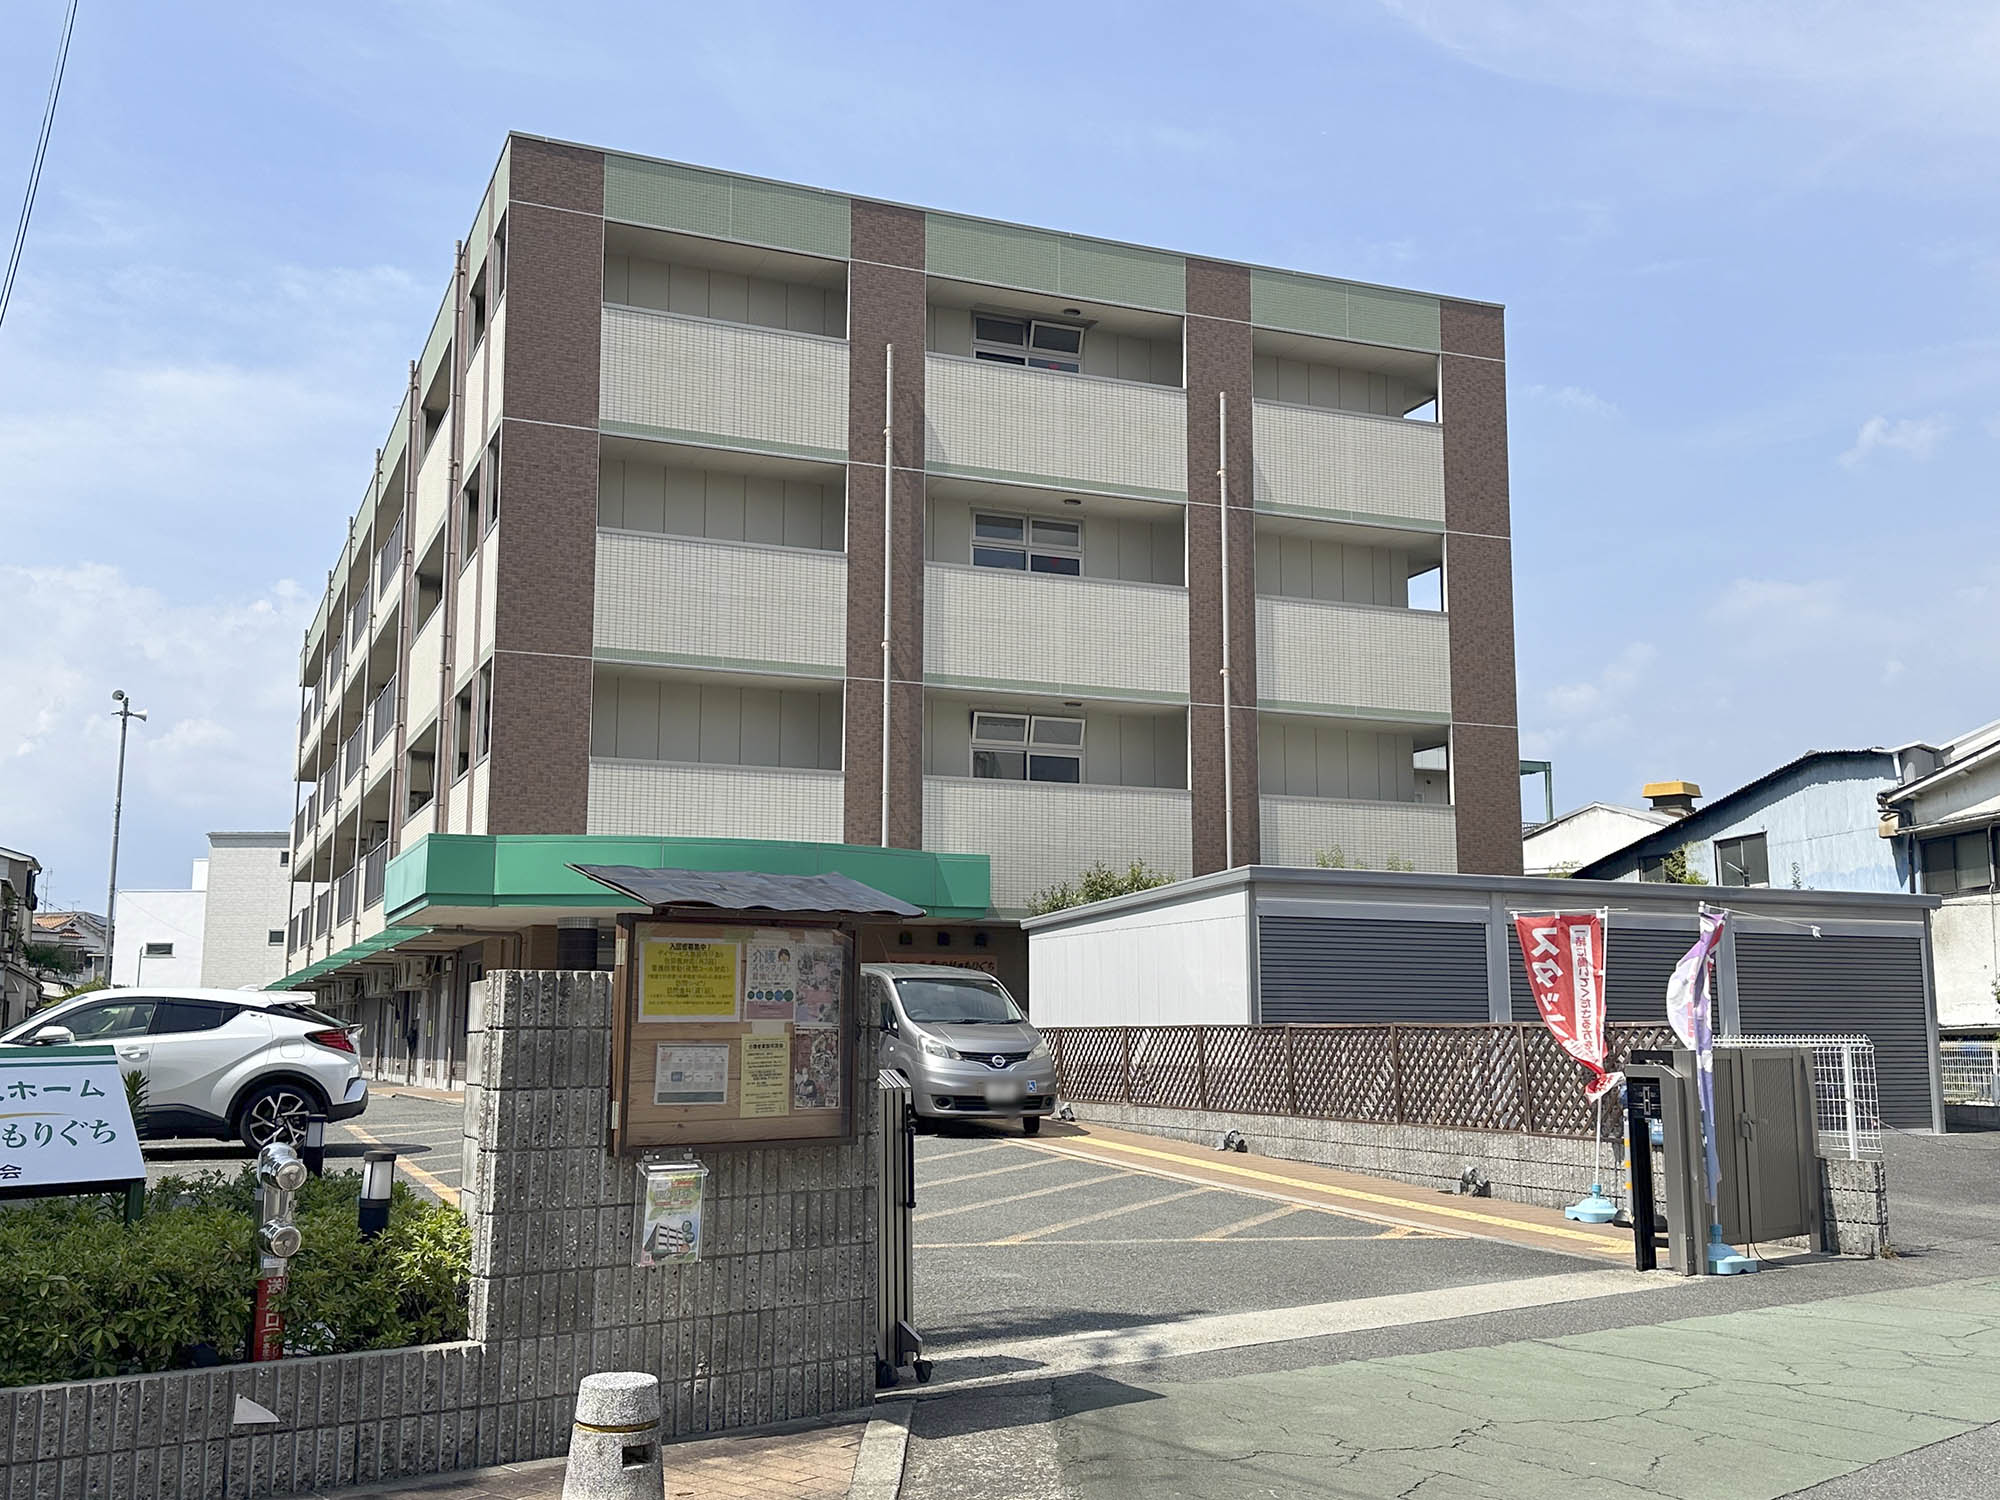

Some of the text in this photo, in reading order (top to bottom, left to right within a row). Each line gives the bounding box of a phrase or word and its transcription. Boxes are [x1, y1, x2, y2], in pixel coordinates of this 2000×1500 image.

[0, 1080, 105, 1100] ホーム
[2, 1119, 117, 1148] もりぐち
[0, 1164, 22, 1180] 会
